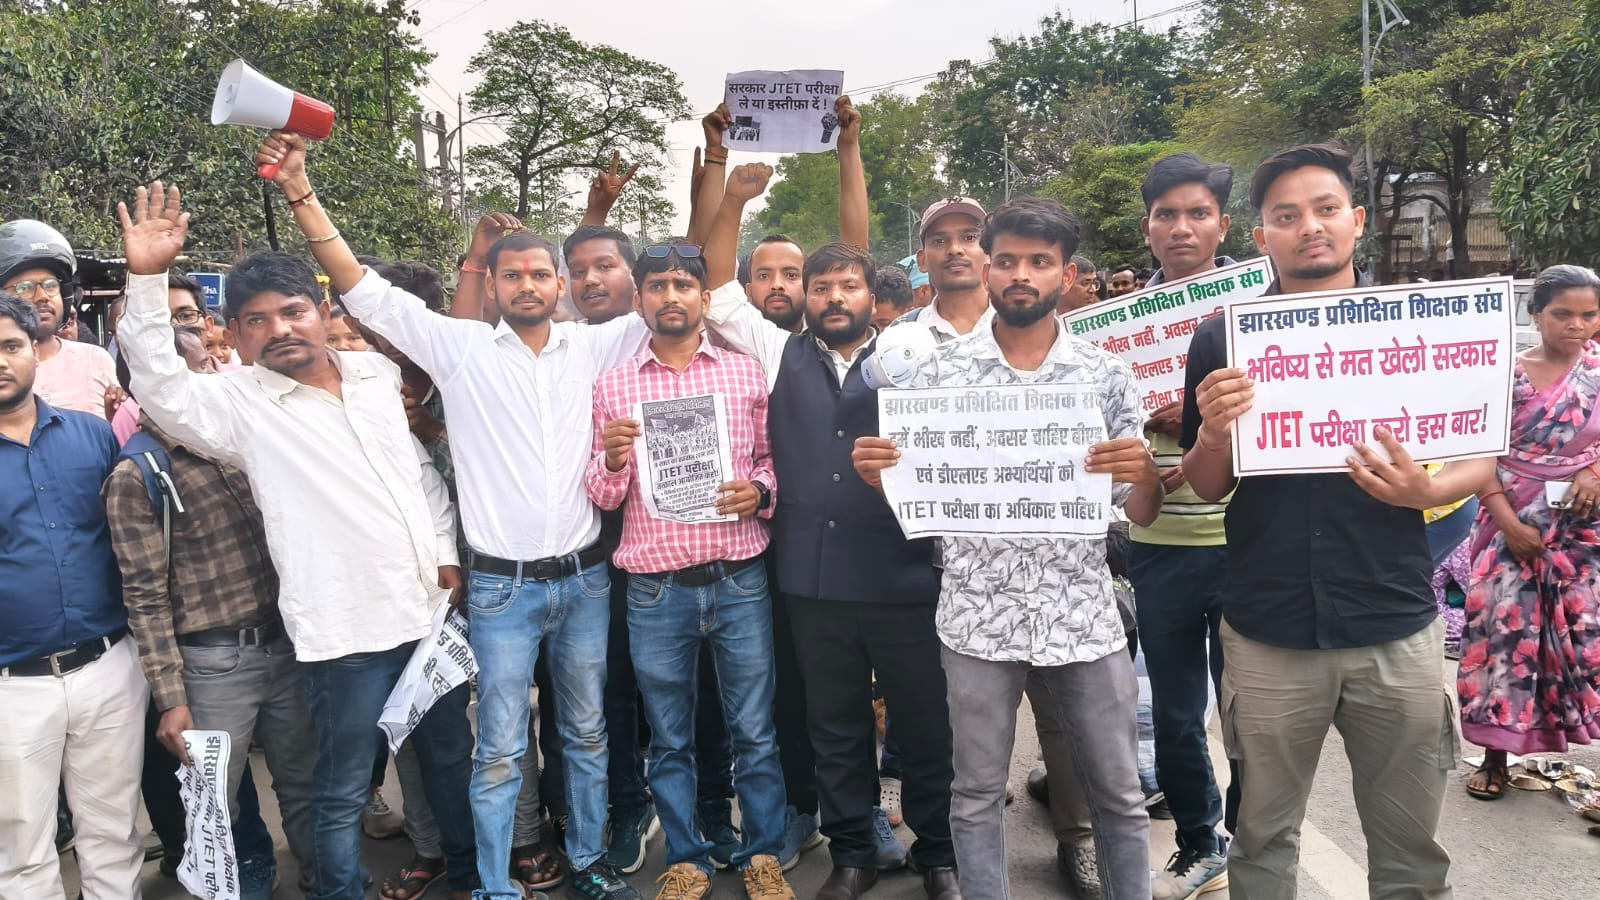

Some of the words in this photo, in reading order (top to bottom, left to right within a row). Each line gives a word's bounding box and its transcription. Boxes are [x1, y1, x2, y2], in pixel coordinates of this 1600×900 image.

[728, 83, 766, 94] सरकार
[769, 82, 802, 94] JTET
[805, 81, 839, 95] परीक्षा
[739, 96, 748, 109] ले
[752, 99, 765, 109] या
[812, 96, 821, 110] दें
[1070, 306, 1127, 336] झारखण्ड
[1128, 289, 1186, 320] प्रशिक्षित
[1186, 276, 1235, 303] शिक्षक
[1239, 268, 1264, 288] संघ
[1238, 306, 1320, 334] झारखण्ड
[1325, 296, 1403, 327] प्रशिक्षित
[1408, 292, 1469, 320] शिक्षक
[1474, 288, 1504, 314] संघ
[1131, 325, 1160, 346] नहीं,
[1247, 345, 1310, 383] भविष्य
[1315, 342, 1334, 380] से
[1339, 349, 1374, 376] मत
[1379, 335, 1427, 376] खेलो
[1432, 338, 1499, 372] सरकार
[885, 396, 949, 416] झारखण्ड
[954, 390, 1018, 414] प्रशिक्षित
[1024, 389, 1076, 411] शिक्षक
[914, 426, 945, 449] भीख
[949, 425, 980, 450] नहीं,
[986, 428, 1028, 448] अवसर
[1033, 422, 1069, 446] चाहिए
[1256, 410, 1303, 450] JTET
[1310, 409, 1366, 448] परीक्षा
[1416, 412, 1447, 445] इस
[1451, 403, 1488, 436] बार!
[659, 465, 682, 481] JTET
[685, 459, 714, 474] परीक्षा
[915, 463, 933, 484] एवं
[937, 463, 988, 485] डीएलएड
[994, 458, 1056, 484] अभ्यर्थियों
[1058, 461, 1074, 482] को
[941, 497, 980, 519] परीक्षा
[984, 503, 1001, 519] का
[1005, 498, 1056, 520] अधिकार
[202, 824, 215, 869] JTET
